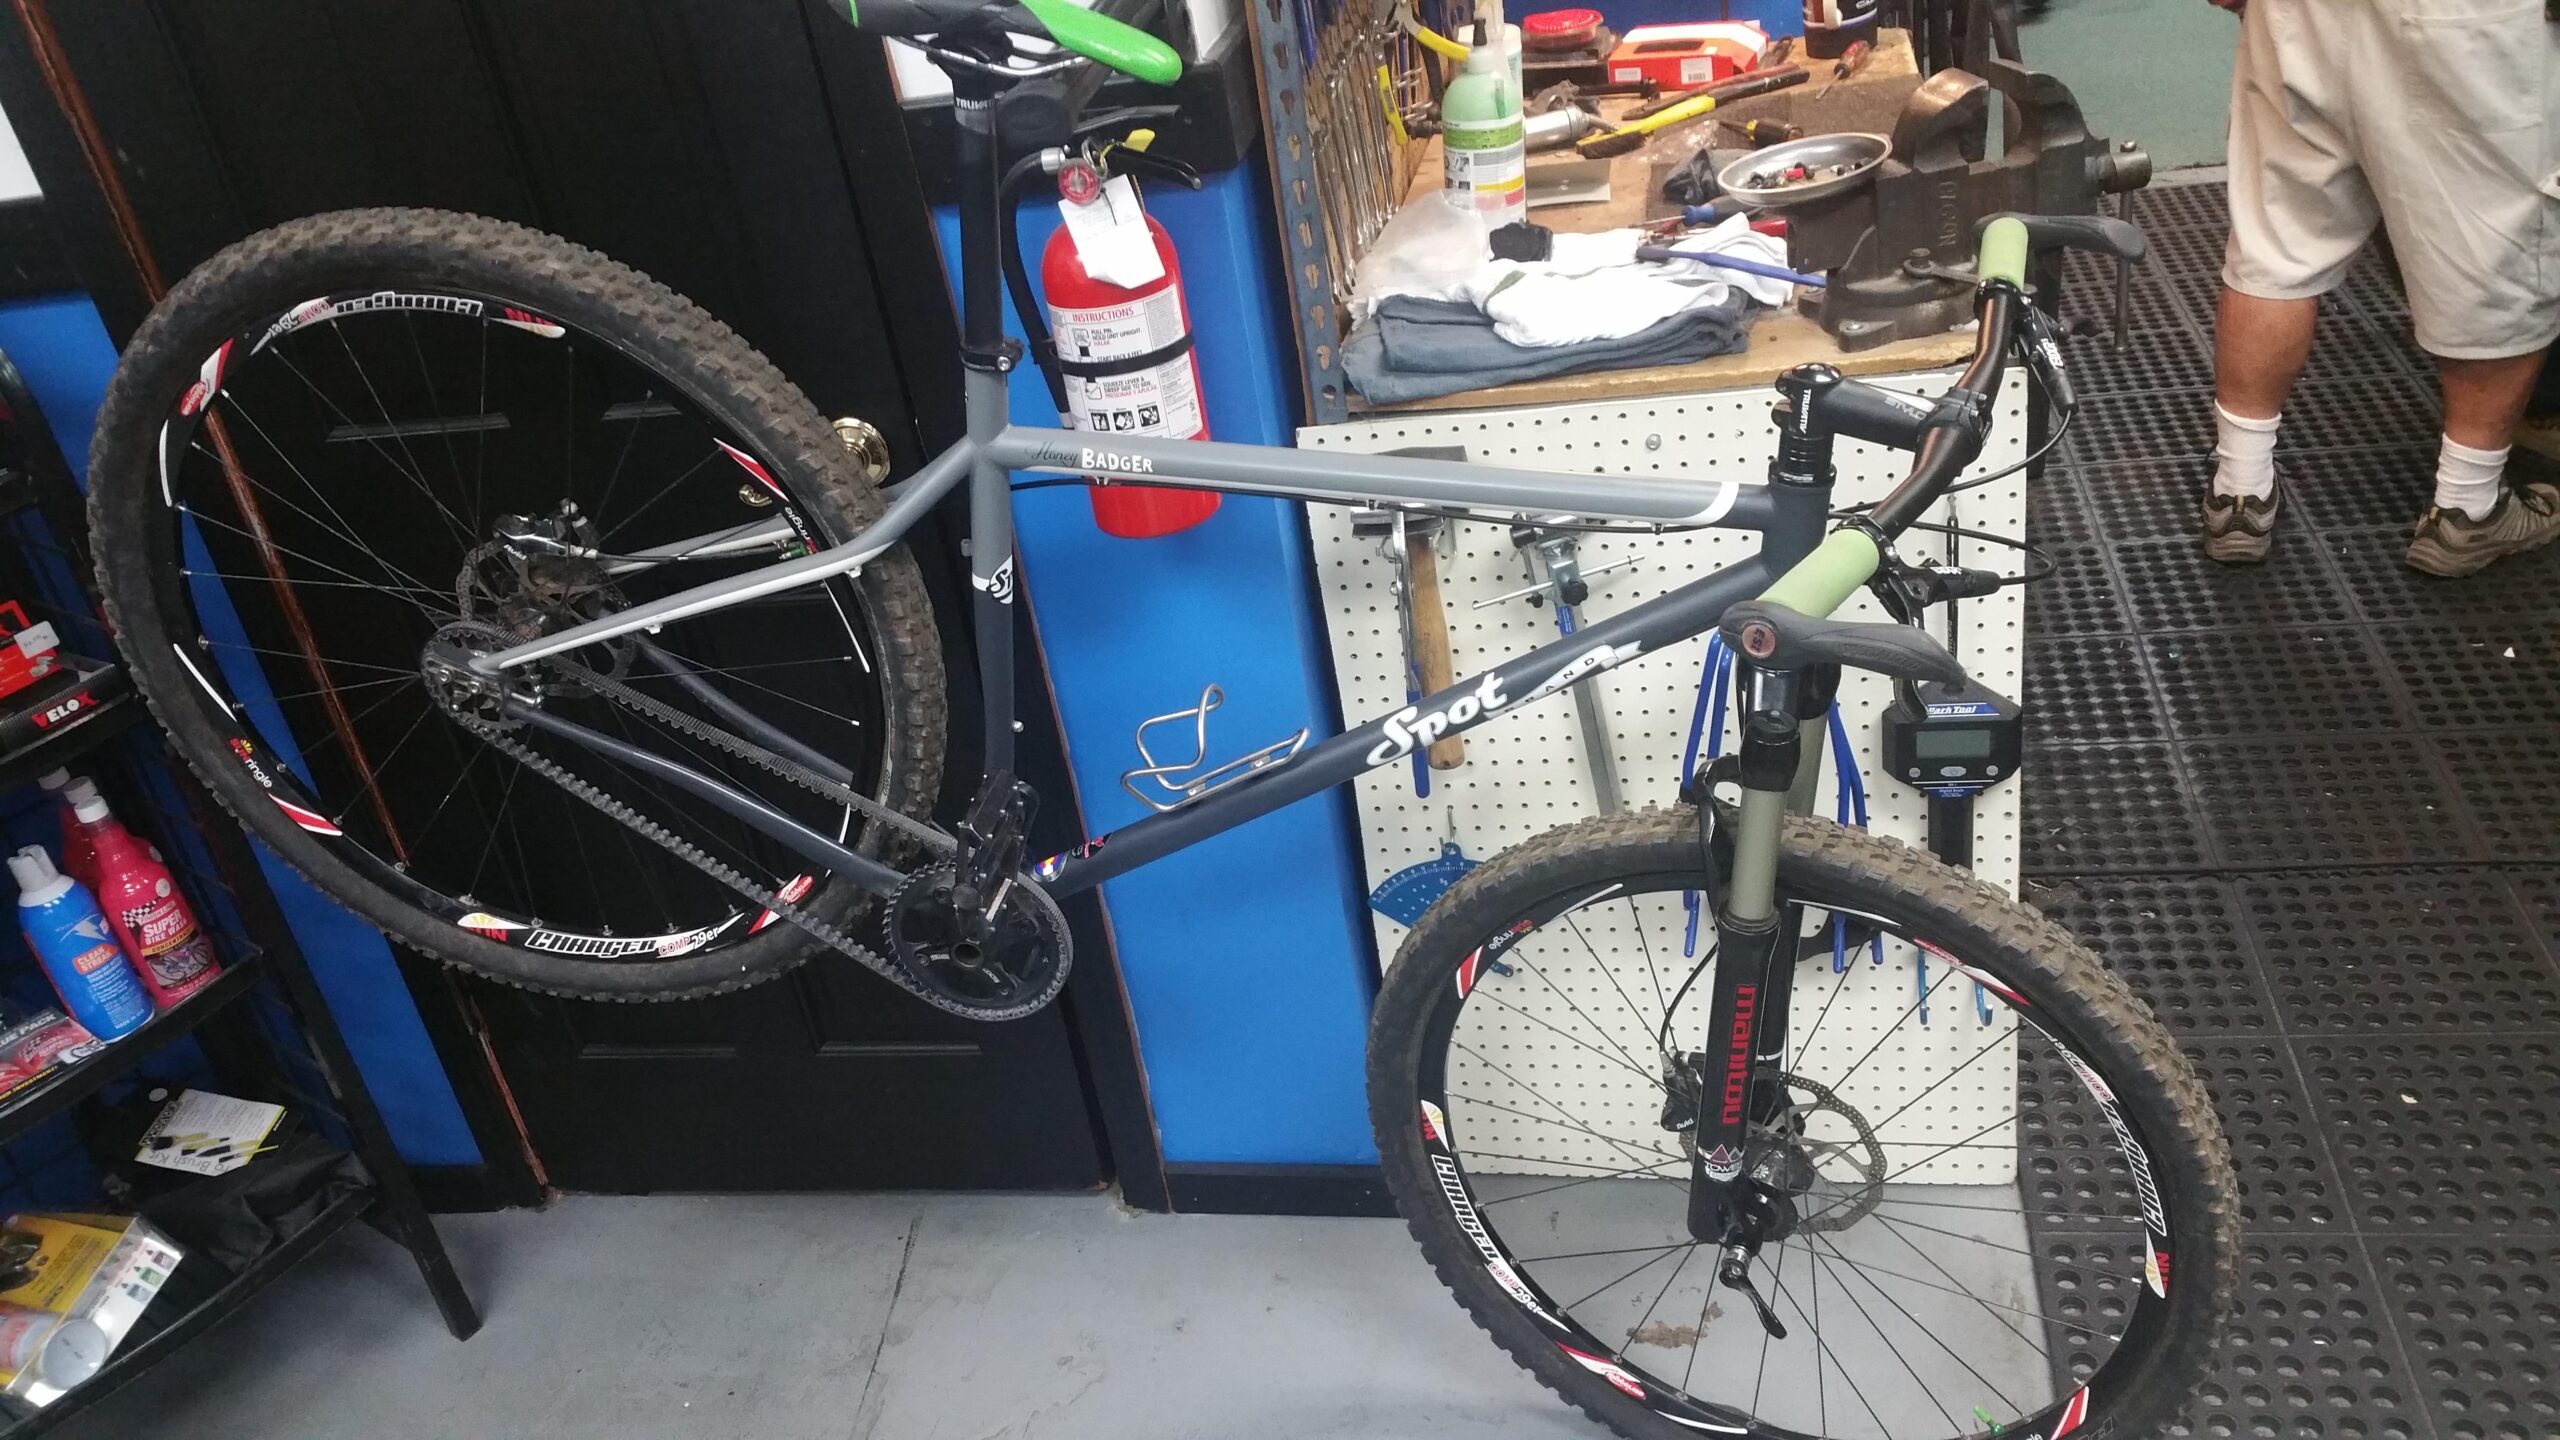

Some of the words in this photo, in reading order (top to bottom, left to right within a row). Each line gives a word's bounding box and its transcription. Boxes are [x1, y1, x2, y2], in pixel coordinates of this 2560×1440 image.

[1072, 306, 1134, 323] INSTRUCTIONS
[1800, 388, 1812, 434] TRUVATIV
[1885, 396, 1927, 420] STYLO
[1025, 440, 1079, 468] Honey
[1081, 447, 1154, 473] BADGER
[1751, 628, 1766, 652] ESI
[32, 690, 97, 728] VELOX
[1367, 672, 1507, 766] Spot
[1928, 705, 1951, 714] Park
[1953, 705, 1977, 714] Tool
[143, 909, 182, 939] SUPER
[145, 932, 167, 946] BIKE
[658, 936, 691, 957] COMP
[690, 926, 720, 950] 29er
[77, 946, 106, 965] CLEAN
[19, 1013, 56, 1035] PACK
[1721, 984, 1757, 1125] manitou
[149, 1151, 170, 1164] Kit
[174, 1154, 211, 1172] Brush
[1488, 1262, 1520, 1290] COMP
[1512, 1286, 1544, 1314] 29er
